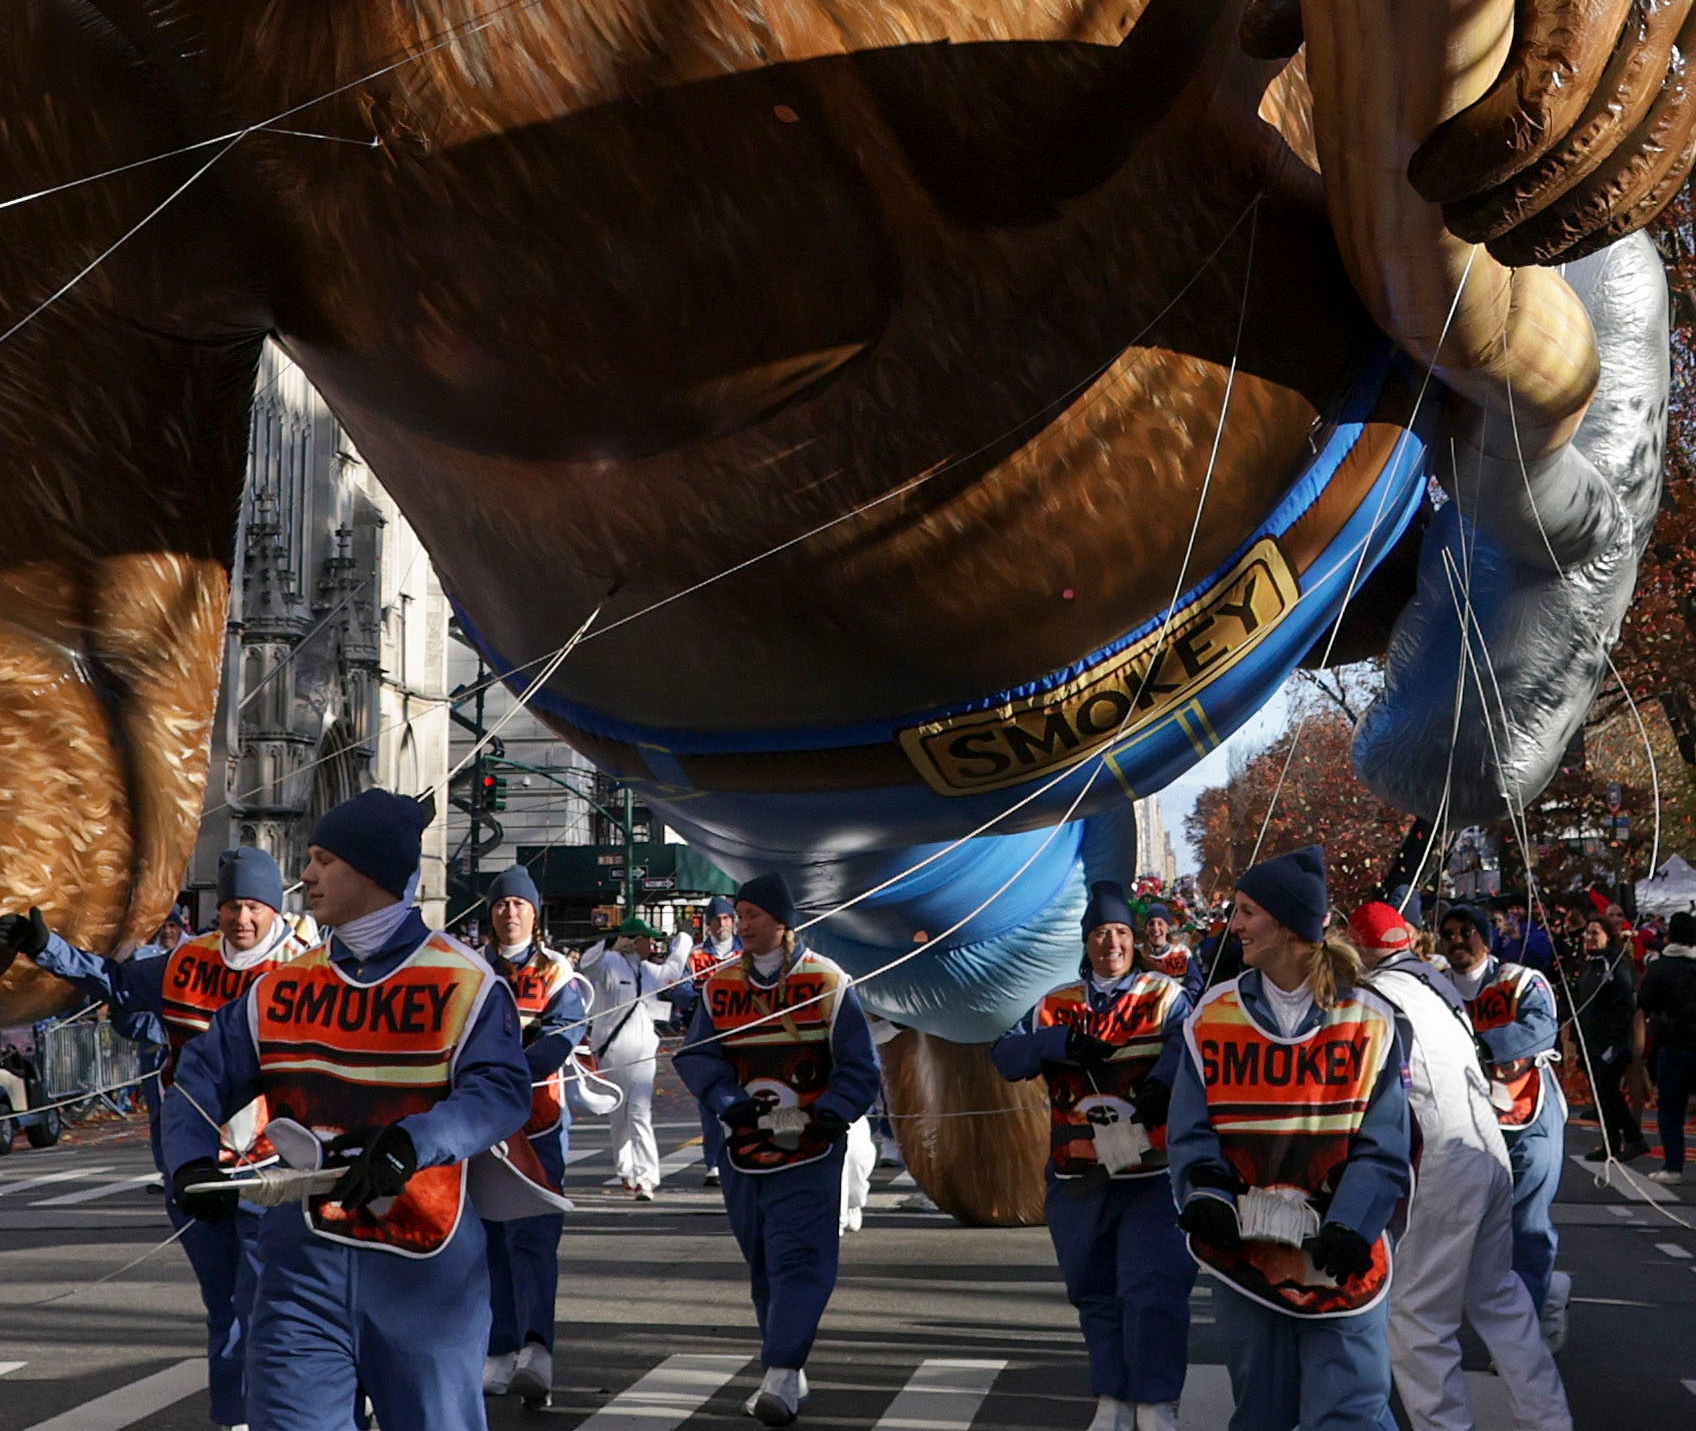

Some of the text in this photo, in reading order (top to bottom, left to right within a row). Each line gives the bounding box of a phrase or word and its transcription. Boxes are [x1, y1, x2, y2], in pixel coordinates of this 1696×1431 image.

[949, 574, 1264, 780] SMOKEY
[268, 980, 459, 1034] SMOKEY
[1201, 1038, 1370, 1086] SMOKEY
